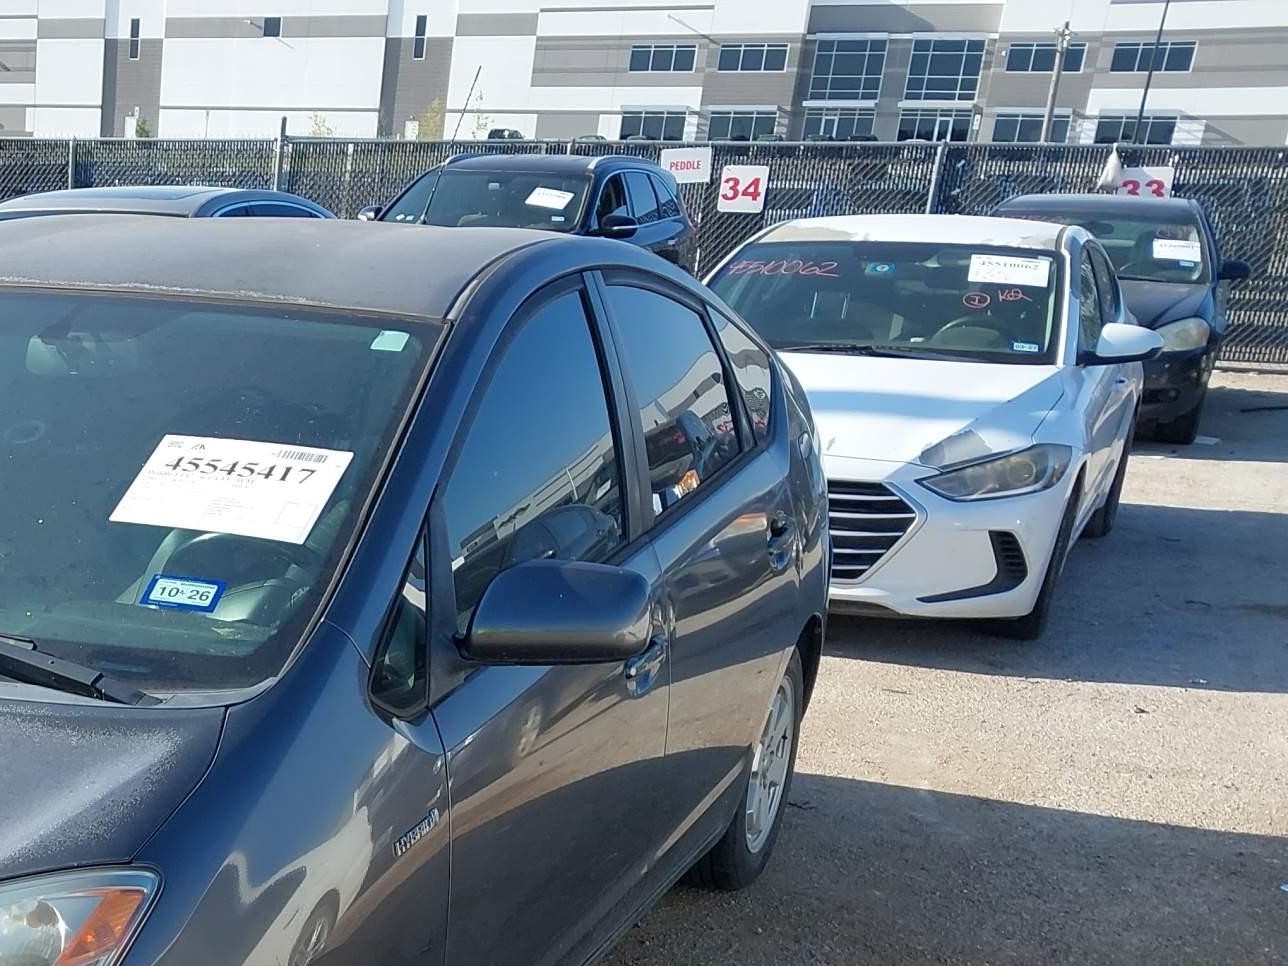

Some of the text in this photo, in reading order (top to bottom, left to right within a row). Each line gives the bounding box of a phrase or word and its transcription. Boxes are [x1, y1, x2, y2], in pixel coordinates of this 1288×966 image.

[669, 160, 702, 171] PEDDLE
[721, 177, 761, 201] 34
[1122, 179, 1165, 197] 33
[165, 456, 318, 484] 45545417
